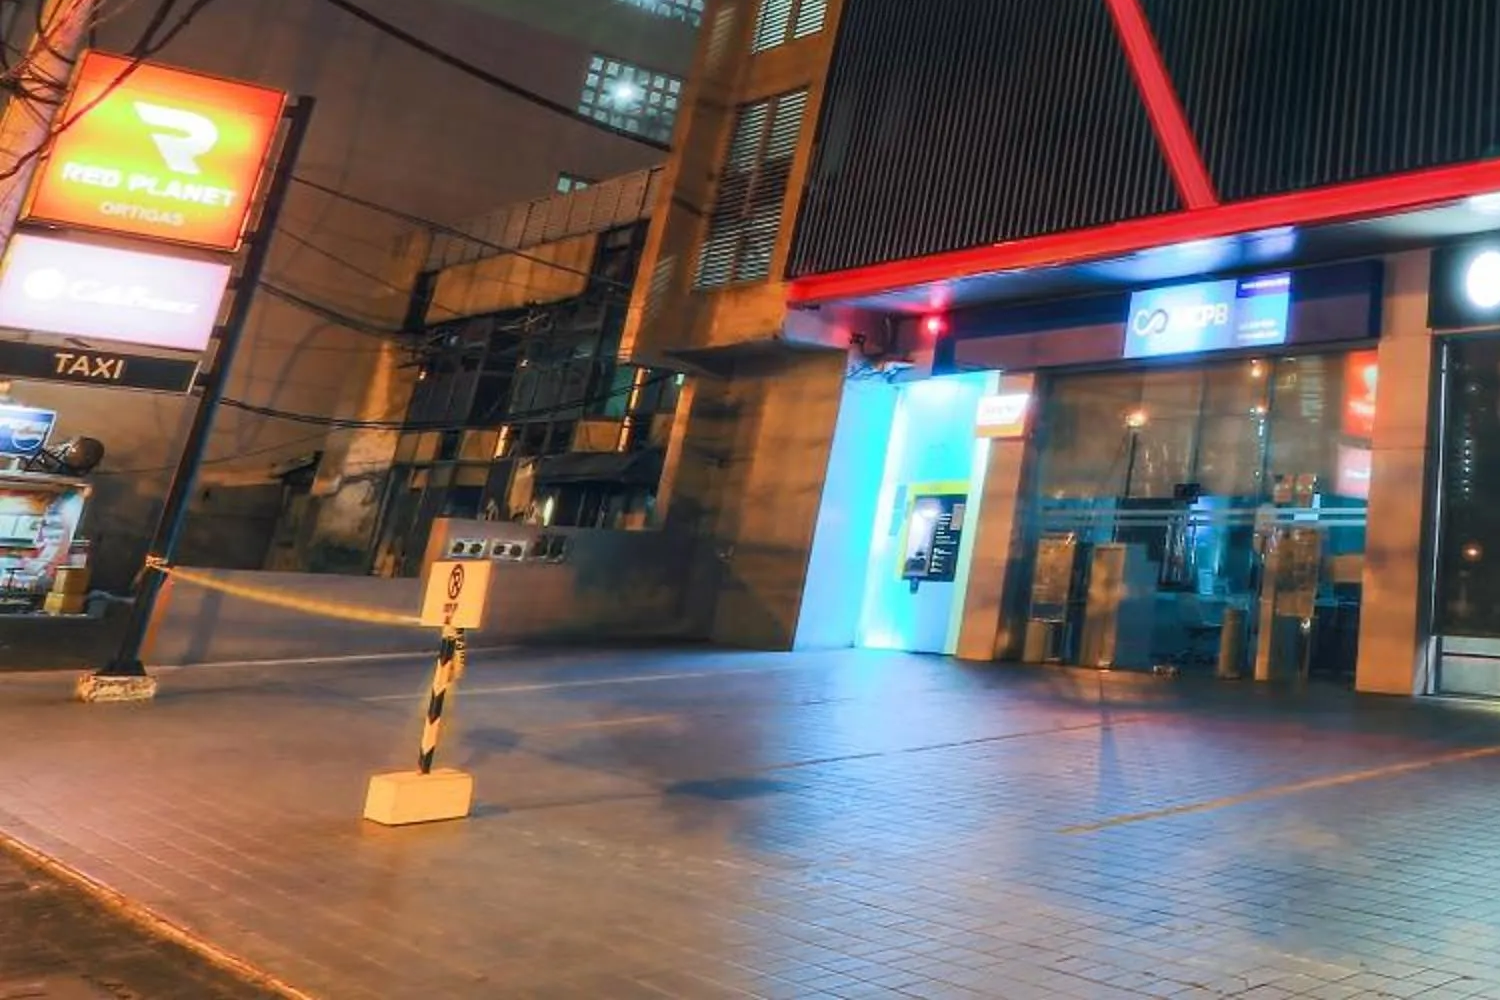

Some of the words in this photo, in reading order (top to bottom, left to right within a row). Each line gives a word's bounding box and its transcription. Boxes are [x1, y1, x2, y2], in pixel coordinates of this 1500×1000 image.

[63, 163, 120, 188] RED
[129, 175, 235, 206] PLANET
[100, 201, 183, 226] ORTIGAS
[54, 352, 125, 380] TAXI
